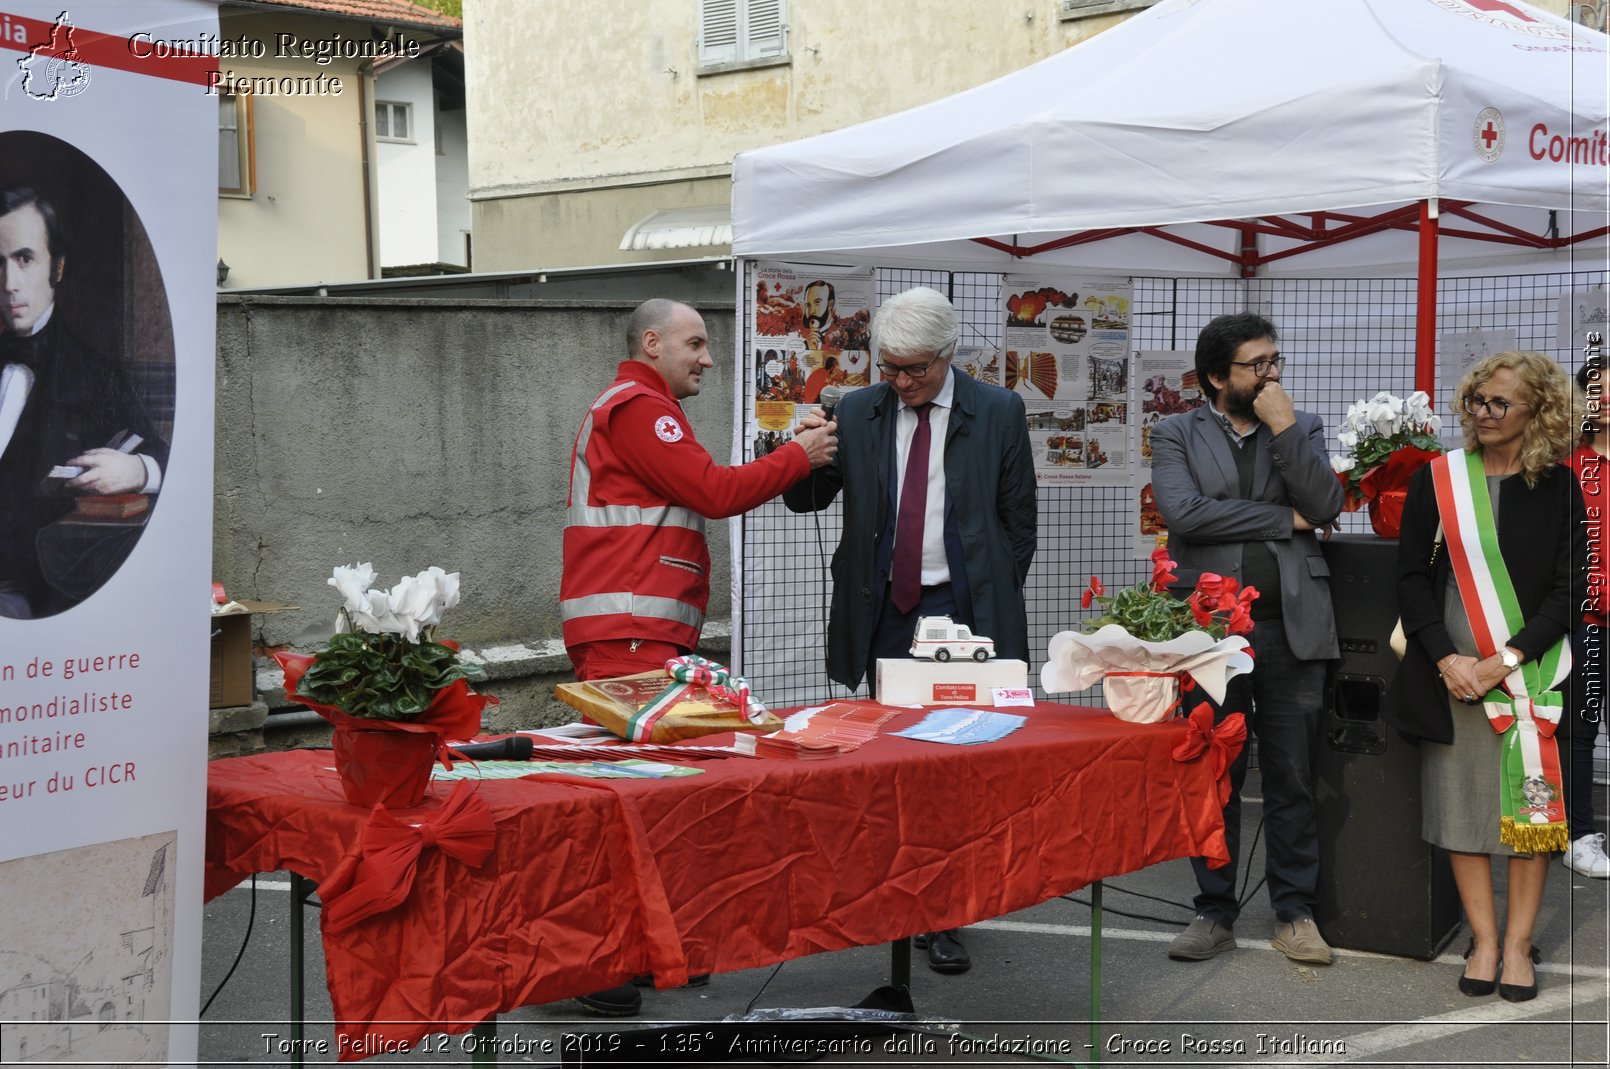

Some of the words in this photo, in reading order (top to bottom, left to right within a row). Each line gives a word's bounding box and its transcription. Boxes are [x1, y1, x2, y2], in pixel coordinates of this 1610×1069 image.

[0, 15, 28, 44] ia
[1528, 122, 1610, 167] Comit
[26, 656, 53, 680] de
[63, 652, 141, 680] guerre
[46, 771, 74, 795] du
[85, 761, 137, 788] CICR
